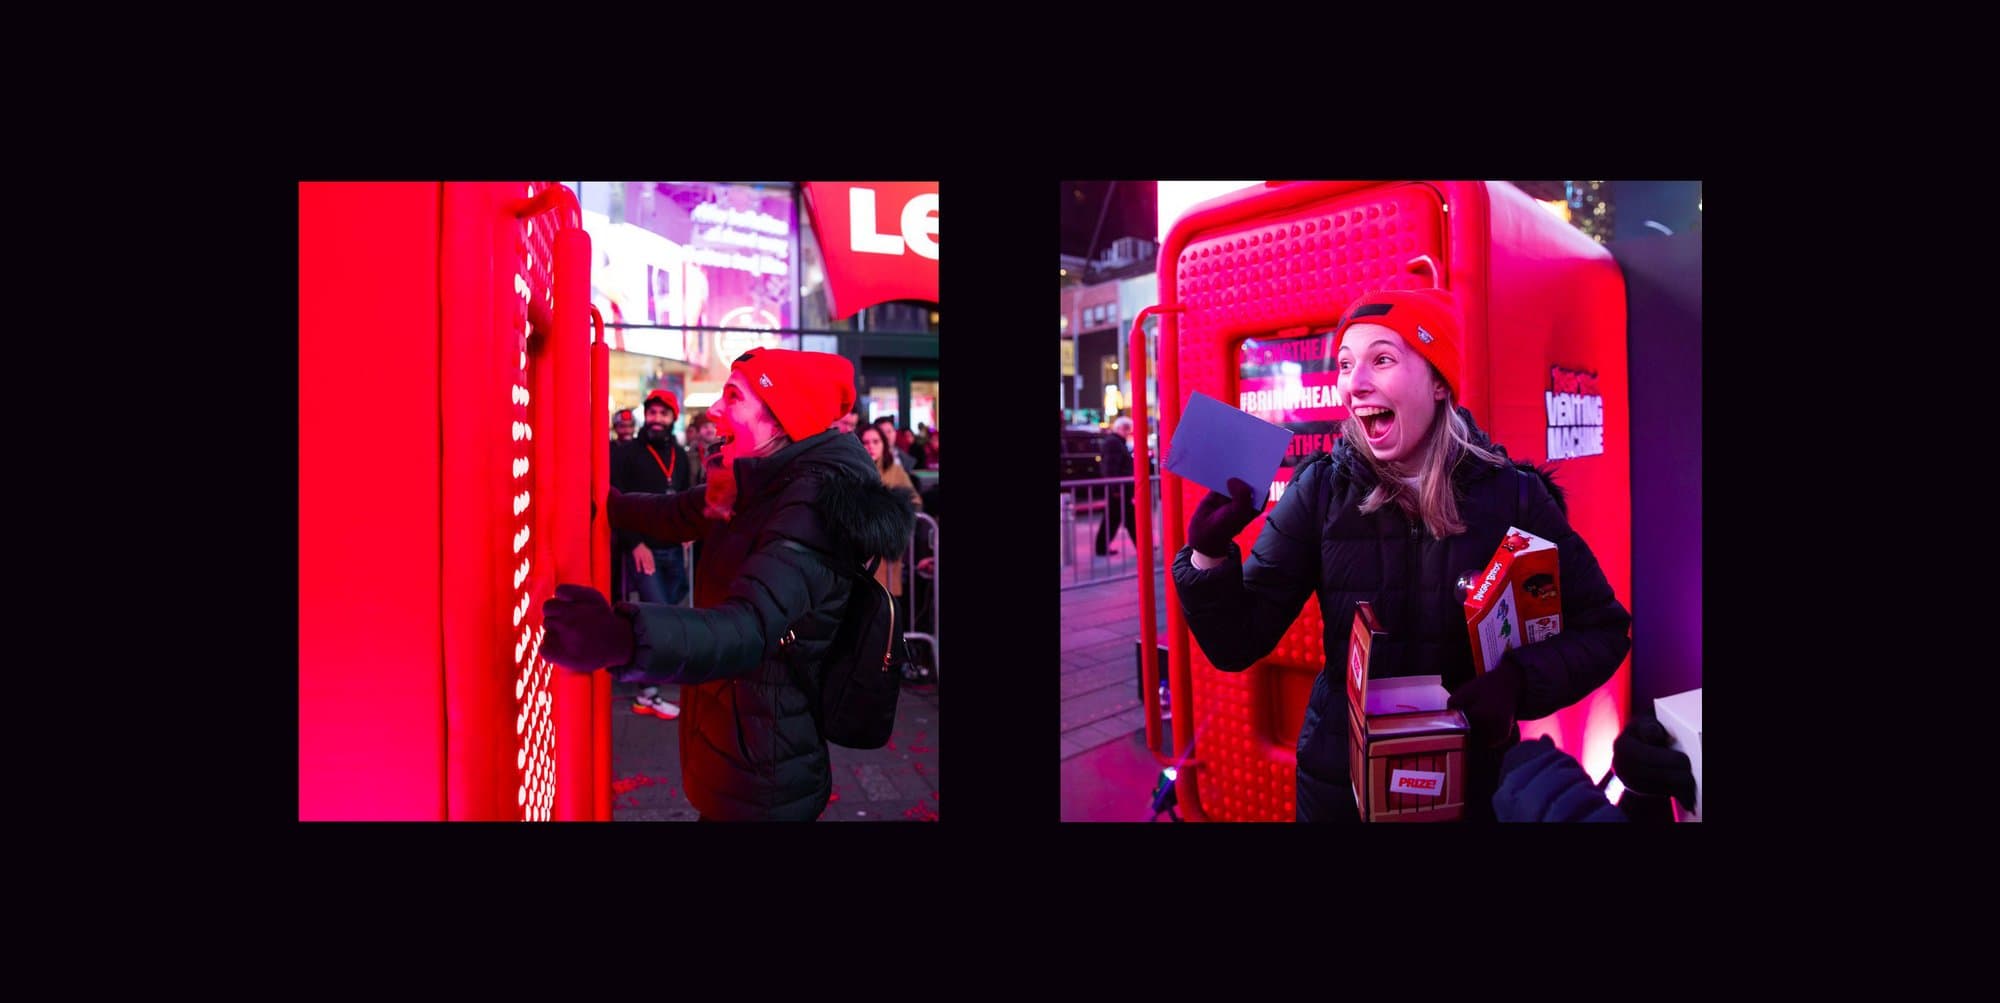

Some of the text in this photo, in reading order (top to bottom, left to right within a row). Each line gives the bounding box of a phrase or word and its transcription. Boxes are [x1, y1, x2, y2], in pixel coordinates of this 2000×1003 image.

[849, 186, 939, 261] Le
[1546, 391, 1603, 426] VENTING
[1547, 427, 1604, 460] MACHINE
